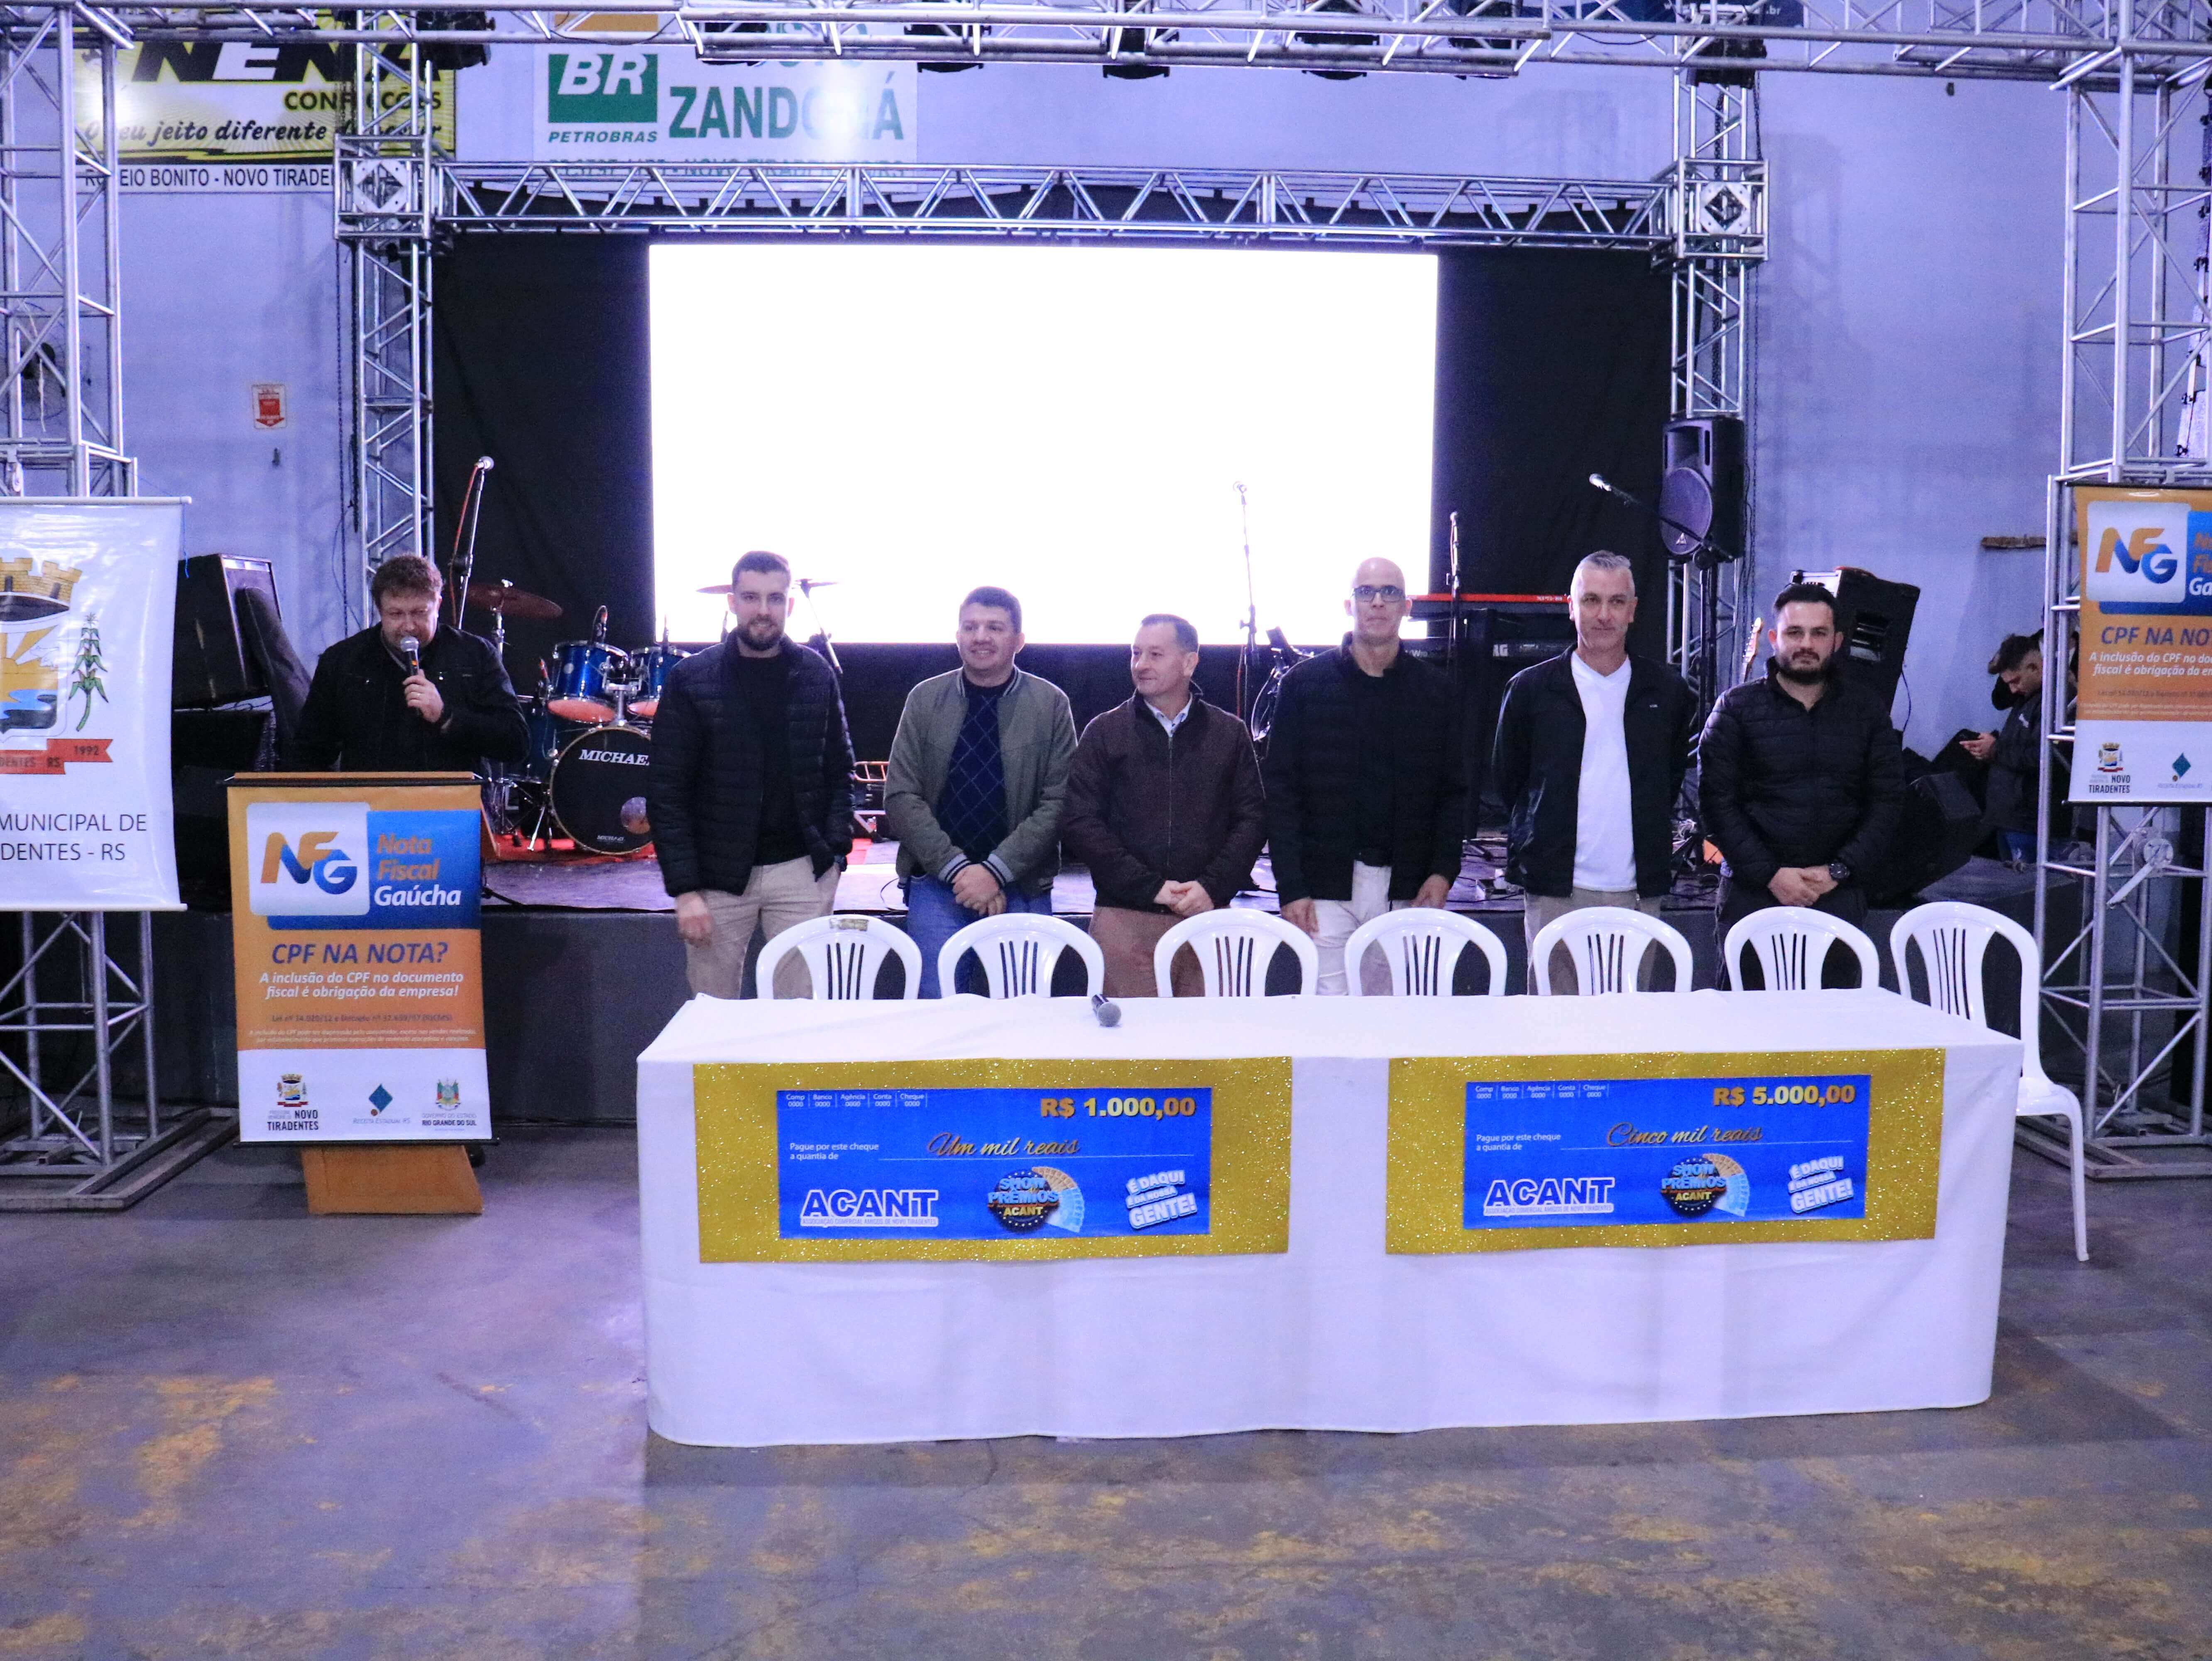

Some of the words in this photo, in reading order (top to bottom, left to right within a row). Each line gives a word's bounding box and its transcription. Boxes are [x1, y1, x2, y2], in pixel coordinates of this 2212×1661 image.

[558, 54, 648, 95] BR
[147, 121, 207, 146] jeito
[215, 120, 326, 140] diferente
[548, 131, 657, 143] PETROBRAS
[151, 169, 209, 186] BONITO
[224, 169, 267, 186] NOVO
[274, 169, 333, 186] TIRADE
[2101, 627, 2140, 644] CPF
[2145, 628, 2173, 644] NA
[2180, 628, 2212, 646] NO
[2089, 652, 2097, 661] A
[2100, 651, 2144, 662] inclusão
[2146, 652, 2160, 662] do
[2163, 653, 2181, 663] CPF
[2092, 664, 2122, 676] fiscal
[2125, 664, 2132, 674] é
[2134, 664, 2185, 677] obrigação
[2187, 665, 2199, 675] da
[75, 745, 99, 756] 1992
[579, 749, 650, 766] MICHAE
[2111, 775, 2131, 783] NOVO
[2089, 785, 2130, 793] TIRADENTES
[120, 814, 147, 831] DE
[1, 843, 81, 860] DENTES
[102, 843, 125, 860] RS
[377, 833, 432, 854] Nota
[377, 858, 440, 881] Fiscal
[374, 884, 461, 906] Gaúcha
[272, 943, 317, 964] CPF
[322, 943, 358, 964] NA
[367, 942, 449, 964] NOTA?
[259, 973, 269, 983] A
[272, 971, 323, 983] inclusão
[327, 972, 343, 983] do
[347, 972, 371, 983] CPF
[373, 975, 389, 983] no
[392, 971, 464, 983] documento
[265, 986, 299, 1000] fiscal
[302, 985, 309, 997] é
[312, 985, 376, 1000] obrigação
[379, 985, 395, 997] da
[399, 985, 459, 999] empresa!
[1713, 1087, 1745, 1107] R$
[1752, 1085, 1855, 1107] 5.000,00
[294, 1110, 318, 1119] NOVO
[1040, 1097, 1076, 1119] R$
[1084, 1097, 1196, 1120] 1.000,00
[267, 1121, 319, 1131] TIRADENTES
[1607, 1122, 1668, 1147] Cinco
[1671, 1125, 1710, 1144] mil
[1711, 1126, 1763, 1141] reais
[790, 1142, 814, 1151] Pague
[849, 1142, 879, 1151] cheque
[927, 1132, 976, 1156] Um
[980, 1137, 1020, 1156] mil
[1025, 1139, 1080, 1154] reais
[1476, 1134, 1500, 1143] Pague
[1533, 1133, 1561, 1142] cheque
[796, 1152, 827, 1161] quantia
[1483, 1144, 1512, 1152] quantia
[1799, 1156, 1844, 1176] DAQUI
[1137, 1170, 1186, 1191] DAQUI
[1483, 1177, 1615, 1207] ACANT
[1675, 1191, 1712, 1201] ACANT
[1791, 1178, 1854, 1213] GENTE!
[800, 1189, 938, 1218] ACANT
[1003, 1206, 1044, 1216] ACANT
[1129, 1192, 1197, 1229] GENTE!
